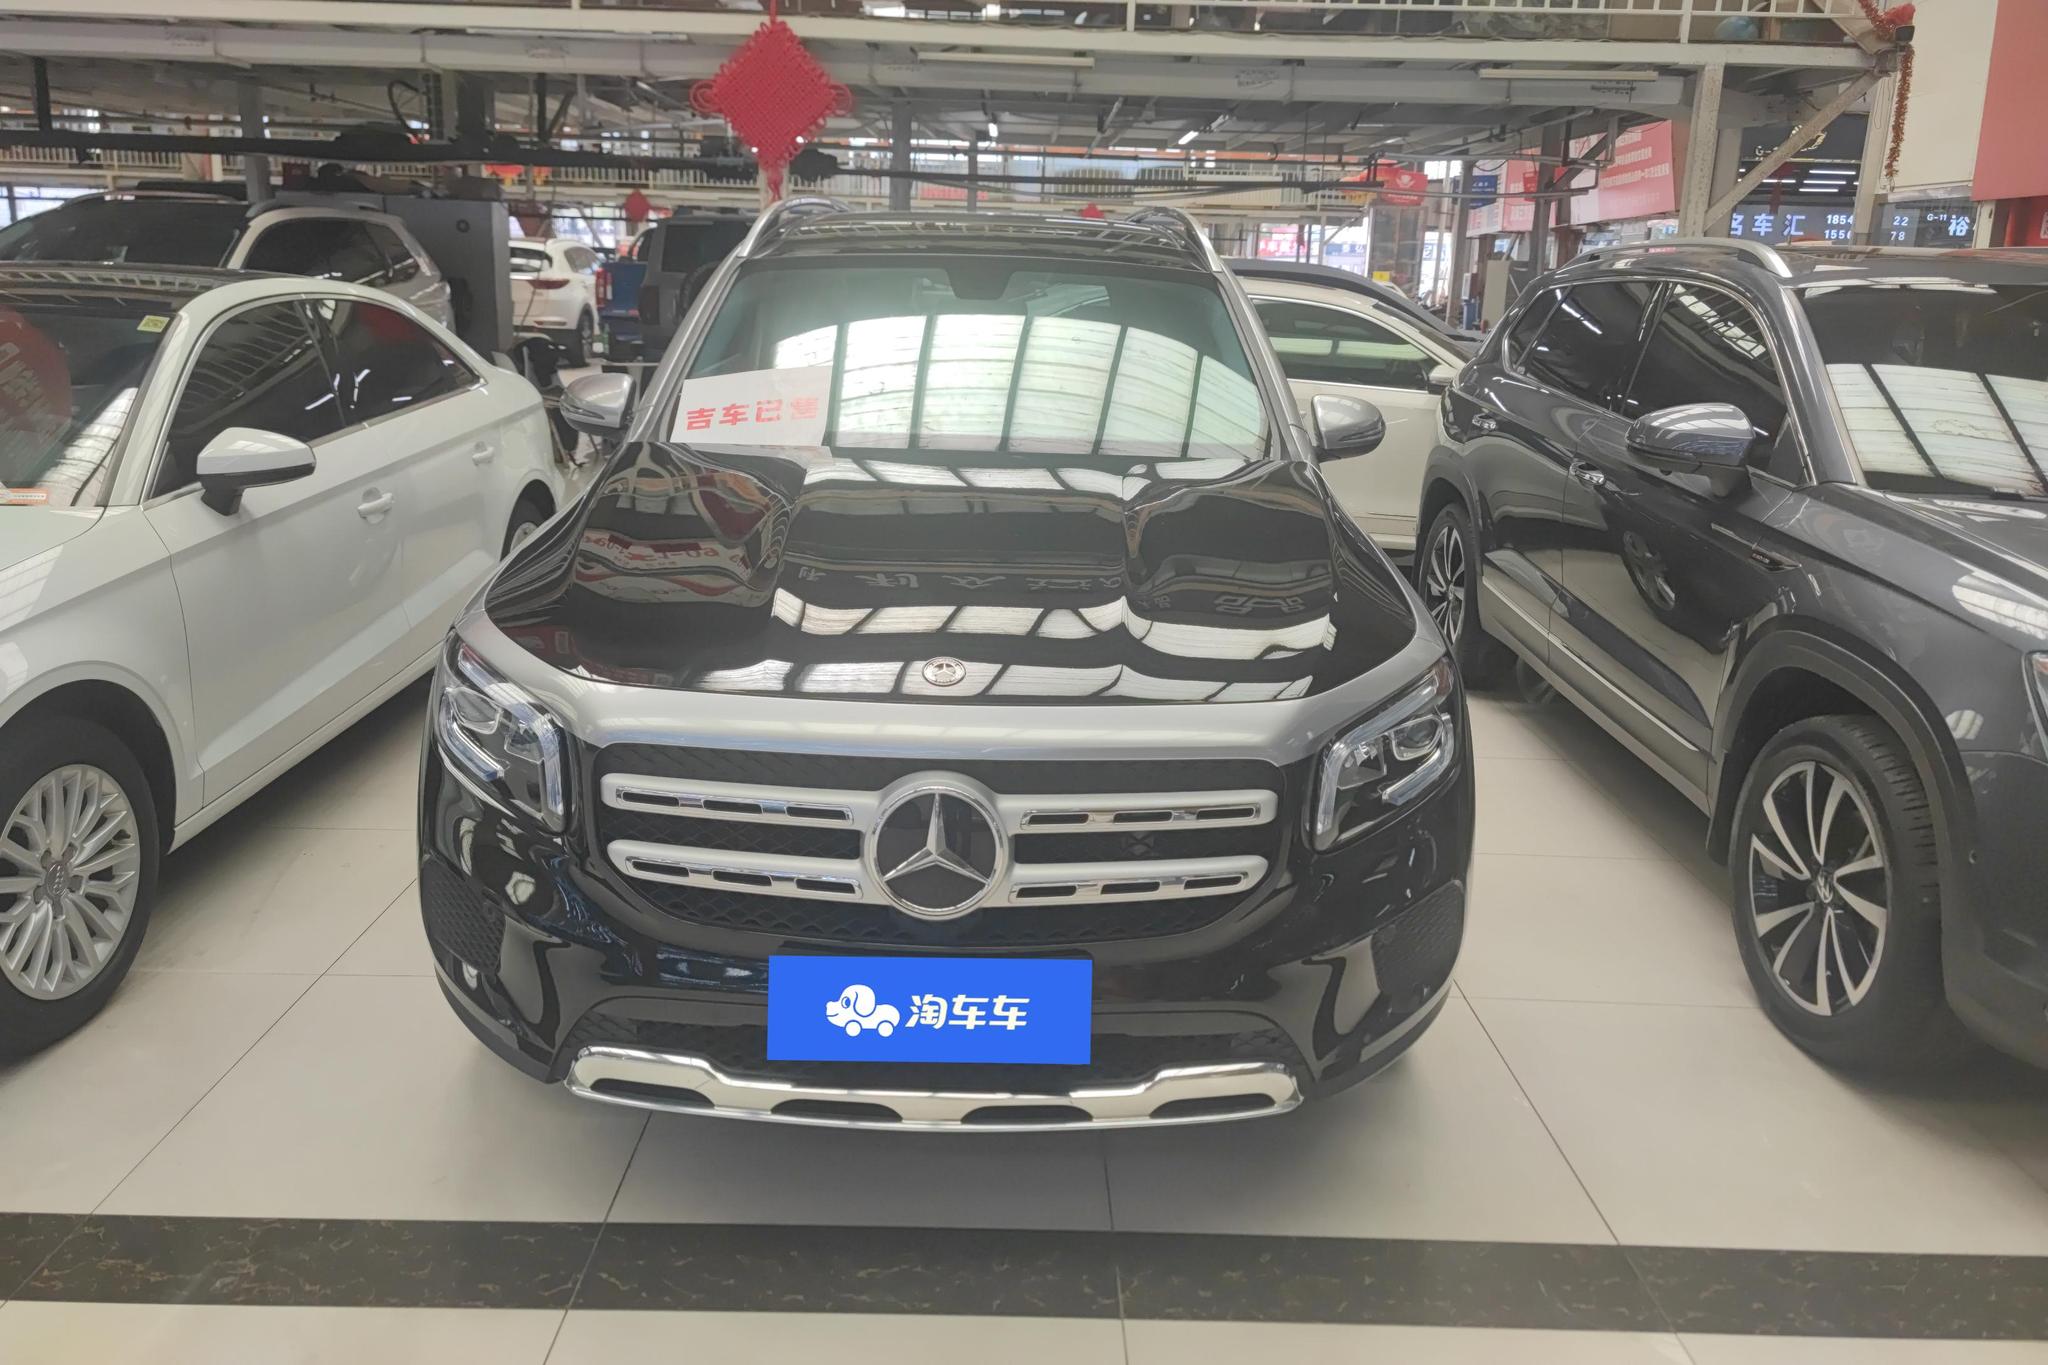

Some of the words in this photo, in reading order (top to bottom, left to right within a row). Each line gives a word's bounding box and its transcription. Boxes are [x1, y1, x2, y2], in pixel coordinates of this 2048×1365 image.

[1892, 215, 1909, 227] 22
[1926, 213, 1948, 221] G-11
[1948, 214, 1975, 237] 裕
[1890, 231, 1906, 241] 78
